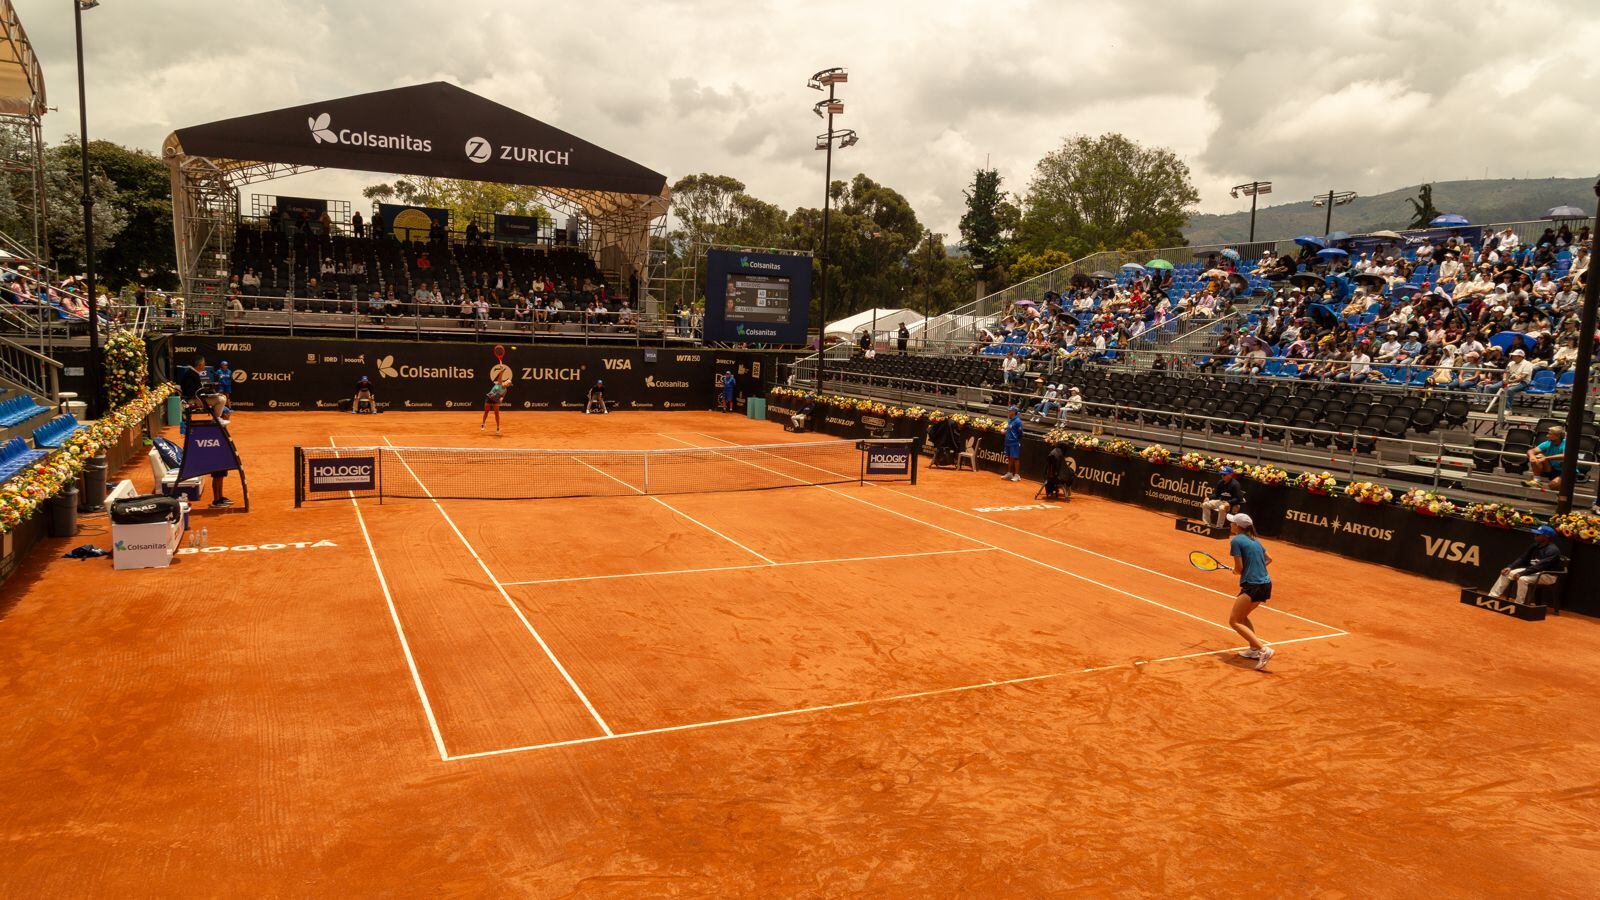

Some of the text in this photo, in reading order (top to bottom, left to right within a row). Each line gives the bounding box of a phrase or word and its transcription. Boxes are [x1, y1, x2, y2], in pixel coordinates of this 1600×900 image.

[339, 127, 432, 152] Colsanitas
[500, 145, 569, 166] ZURICH
[749, 261, 781, 270] Colsanitas
[745, 328, 777, 336] Colsanitas
[217, 343, 252, 351] WTA 250
[602, 358, 632, 370] VISA
[676, 354, 691, 362] WTA
[251, 372, 291, 381] ZURICH
[400, 365, 474, 379] Colsanitas
[521, 367, 581, 380] ZURICH
[655, 379, 689, 388] Colsanitas
[829, 416, 855, 426] DUNLOP
[195, 439, 220, 448] VISA
[870, 454, 907, 463] HOLOGIC
[977, 448, 1009, 464] olsanita
[314, 465, 370, 476] HOLOGIC
[1077, 465, 1121, 486] ZURICH
[1150, 472, 1213, 498] Canola Life
[1149, 489, 1159, 498] Los
[1159, 493, 1183, 504] expertos
[1285, 508, 1392, 541] STELLA ARTOIS
[127, 543, 167, 551] Colsanitas
[1420, 534, 1480, 567] VISA
[1476, 595, 1516, 615] KIA
